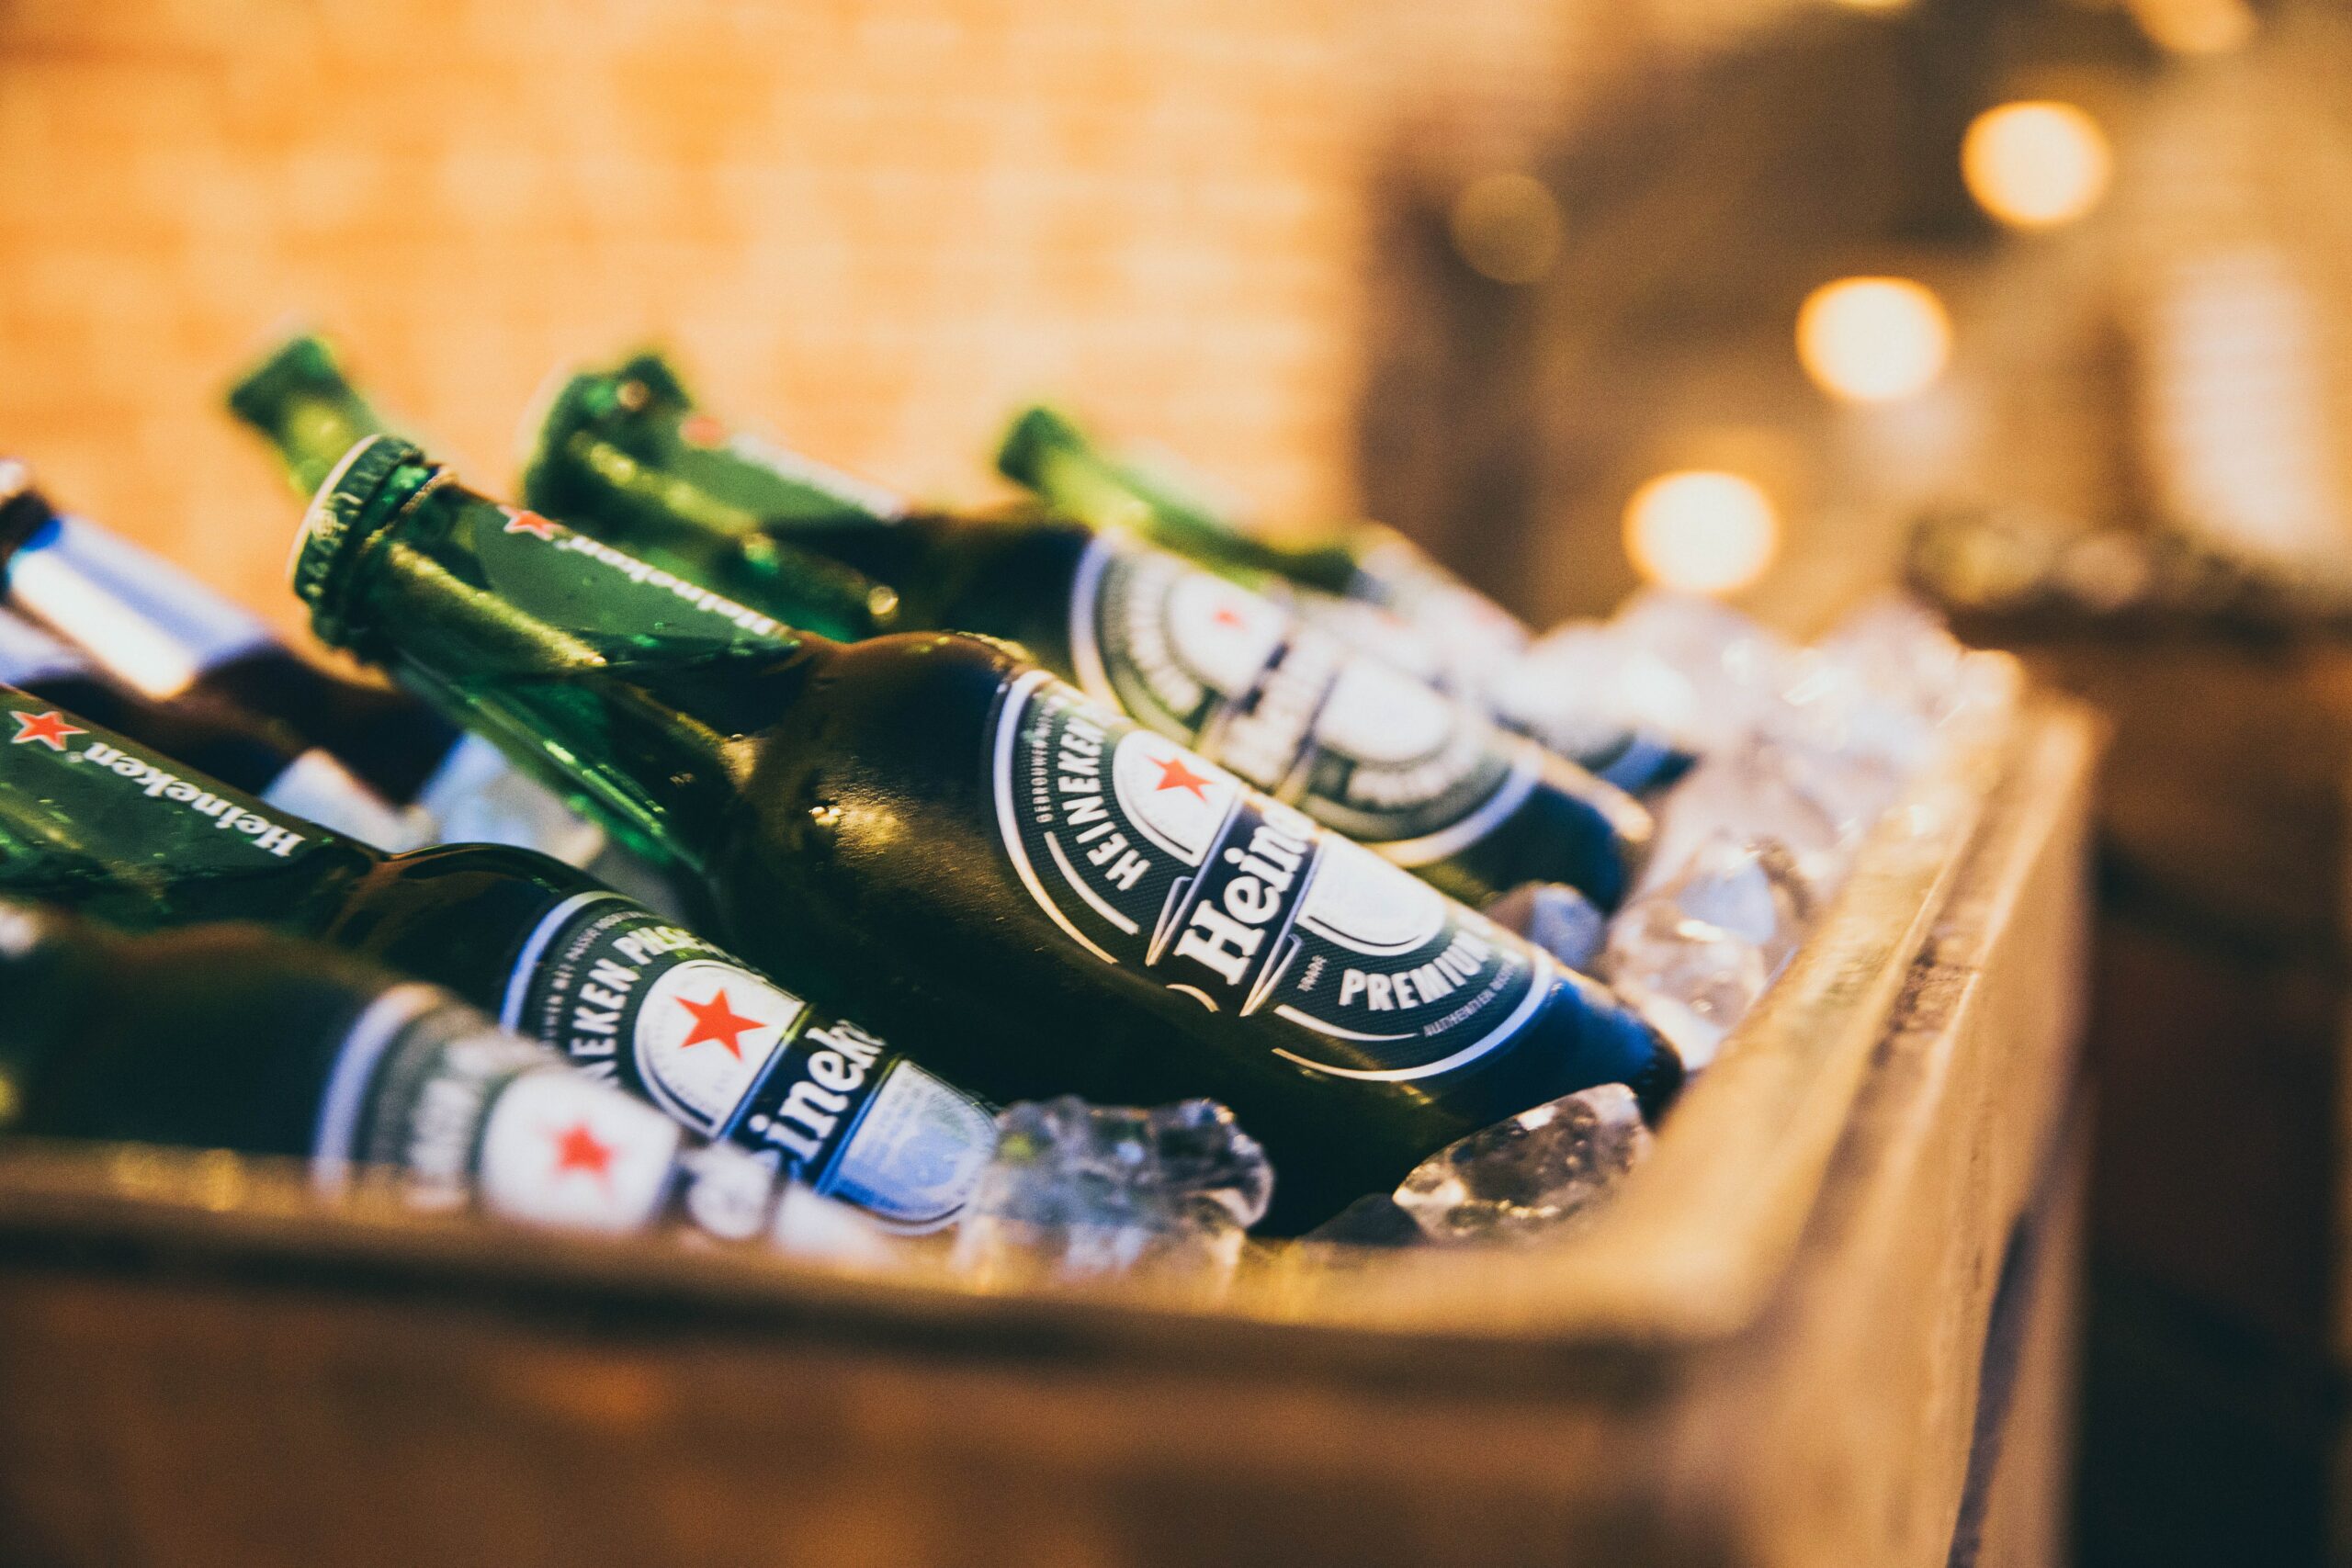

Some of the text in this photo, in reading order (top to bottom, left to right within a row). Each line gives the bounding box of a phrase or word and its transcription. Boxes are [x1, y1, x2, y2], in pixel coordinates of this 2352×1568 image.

[83, 741, 307, 858] Heineken
[1057, 715, 1151, 892] HEINEKEN
[1172, 803, 1314, 987] Hein
[747, 1019, 888, 1165] inek
